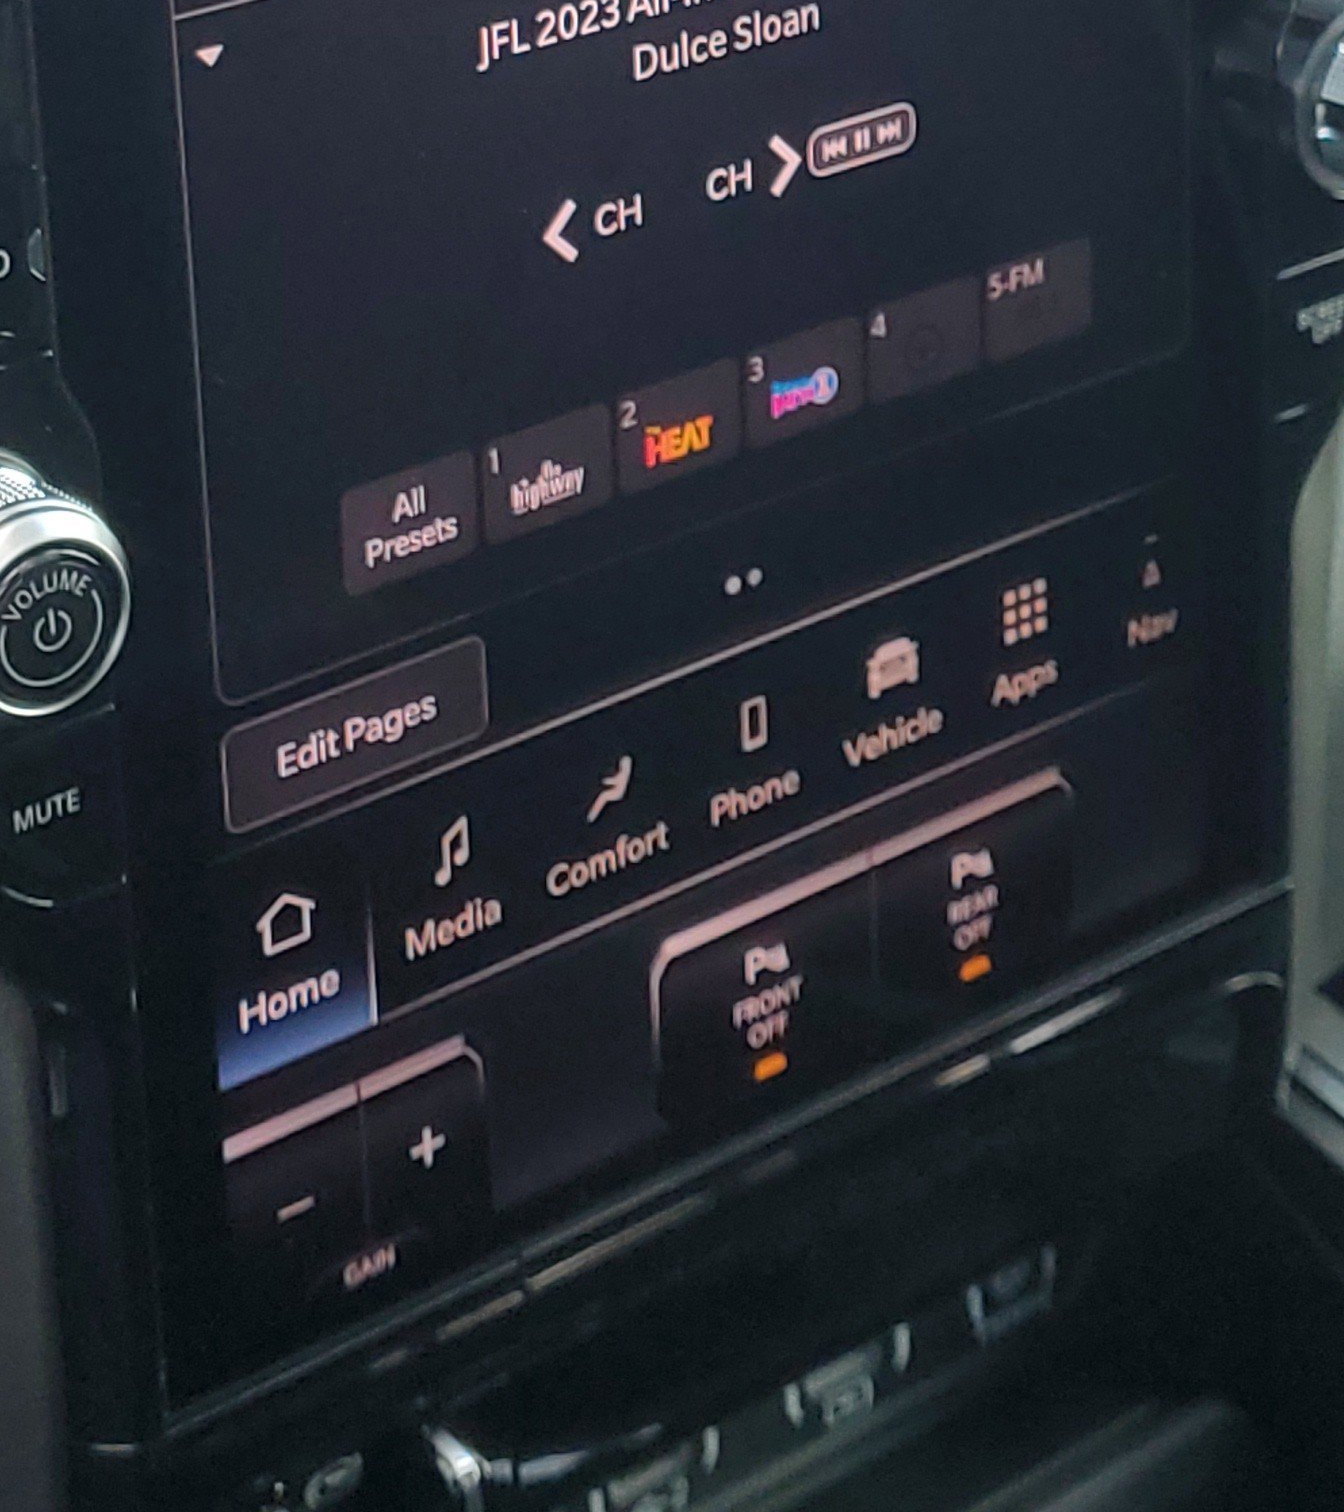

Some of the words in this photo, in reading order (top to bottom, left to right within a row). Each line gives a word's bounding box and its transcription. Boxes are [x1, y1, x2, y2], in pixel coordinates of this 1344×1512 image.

[475, 17, 532, 74] JFL
[631, 28, 728, 83] Dulce
[732, 0, 821, 52] Sloan
[705, 157, 754, 202] CH
[592, 191, 645, 238] CH
[869, 308, 888, 340] 4
[747, 355, 765, 385] 3
[619, 399, 640, 430] 2
[391, 484, 427, 524] All
[363, 515, 459, 570] Presets
[1, 568, 94, 622] VOLUME
[990, 658, 1059, 708] Apps
[275, 726, 341, 779] Edit
[342, 693, 440, 753] Pages
[841, 705, 945, 768] Vehicle
[12, 787, 83, 835] MUTE
[710, 768, 802, 828] Phone
[545, 819, 672, 898] Comfort
[403, 894, 504, 963] Media
[236, 966, 342, 1036] Home
[732, 973, 804, 1031] FRONT
[746, 1008, 789, 1050] OFF
